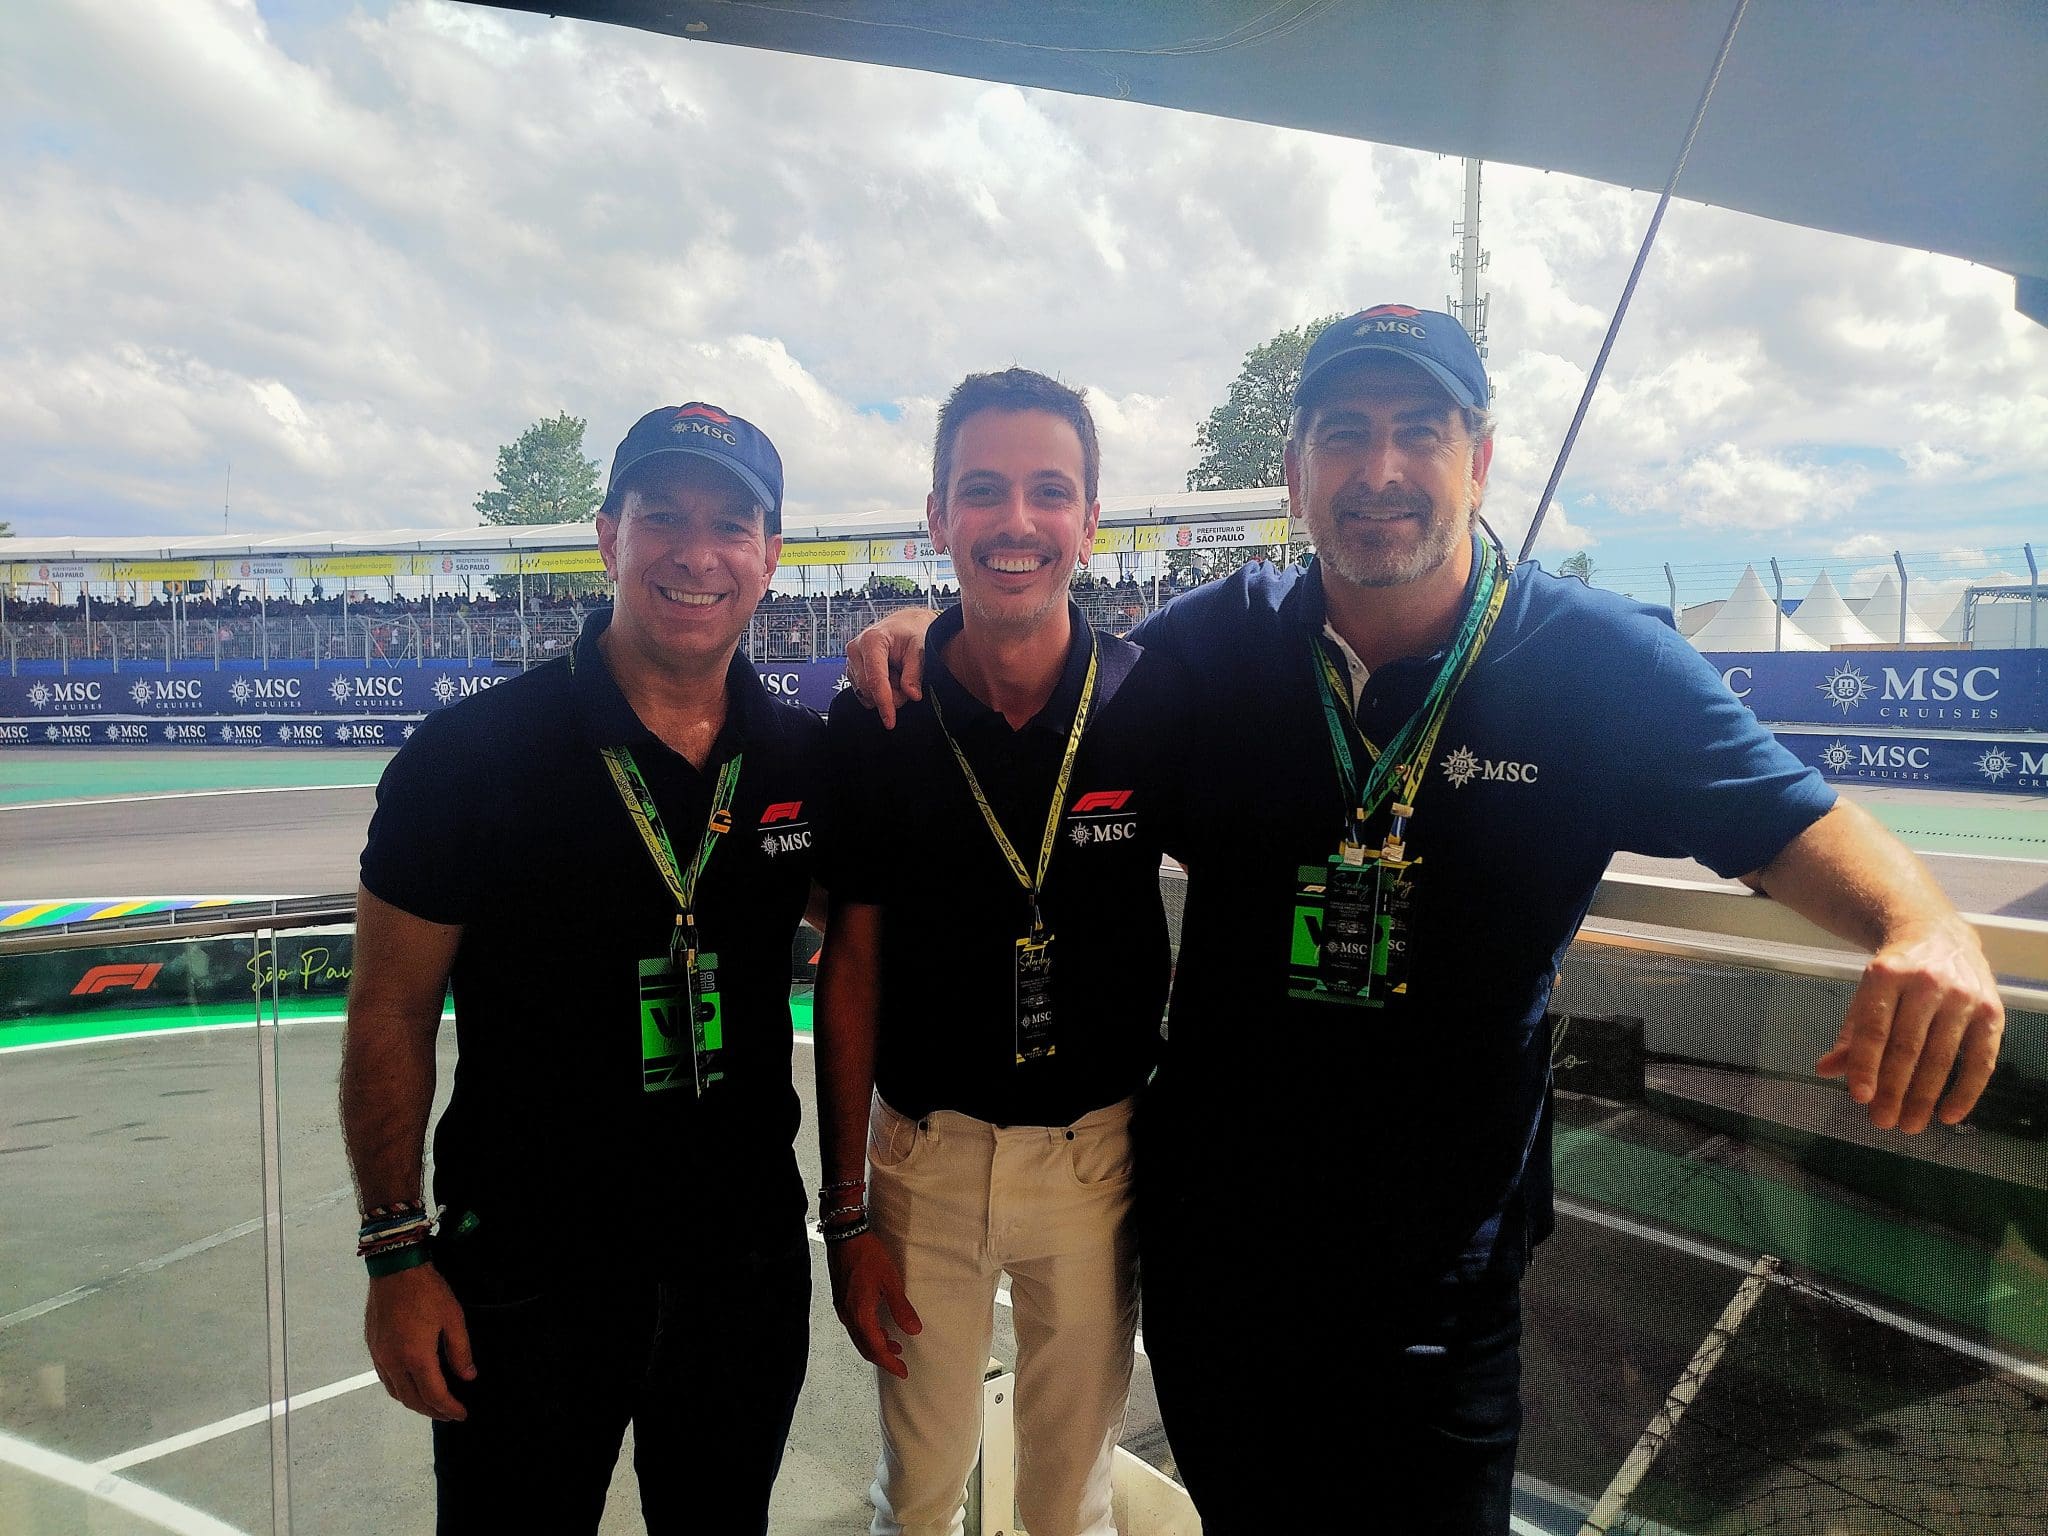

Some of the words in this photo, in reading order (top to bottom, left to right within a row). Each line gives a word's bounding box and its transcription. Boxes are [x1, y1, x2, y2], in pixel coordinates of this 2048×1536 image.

[1375, 321, 1426, 339] MSC
[691, 422, 737, 446] MSC
[1196, 533, 1215, 543] SÃO
[1216, 533, 1245, 542] PAULO
[53, 681, 101, 701] MSC
[156, 680, 202, 700] MSC
[254, 678, 301, 698] MSC
[355, 676, 403, 698] MSC
[459, 676, 509, 697] MS
[1881, 667, 2000, 701] MSC
[255, 700, 302, 708] CRUISES
[355, 699, 404, 707] CRUISES
[1880, 707, 1999, 719] CRUISES
[0, 726, 29, 738] MSC
[61, 725, 91, 737] MSC
[120, 724, 148, 738] MSC
[178, 725, 207, 738] MSC
[234, 725, 262, 738] MSC
[293, 725, 323, 738] MSC
[352, 725, 384, 738] MSC
[1859, 744, 1930, 769] MSC
[1481, 760, 1538, 783] MSC
[1858, 770, 1930, 780] CRUISES
[613, 770, 638, 807] SATURDAY
[1093, 822, 1137, 842] MSC
[779, 831, 812, 852] MSC
[1341, 941, 1368, 955] MSC
[1387, 939, 1407, 952] SC
[246, 951, 294, 992] São
[1032, 1011, 1052, 1024] MSC
